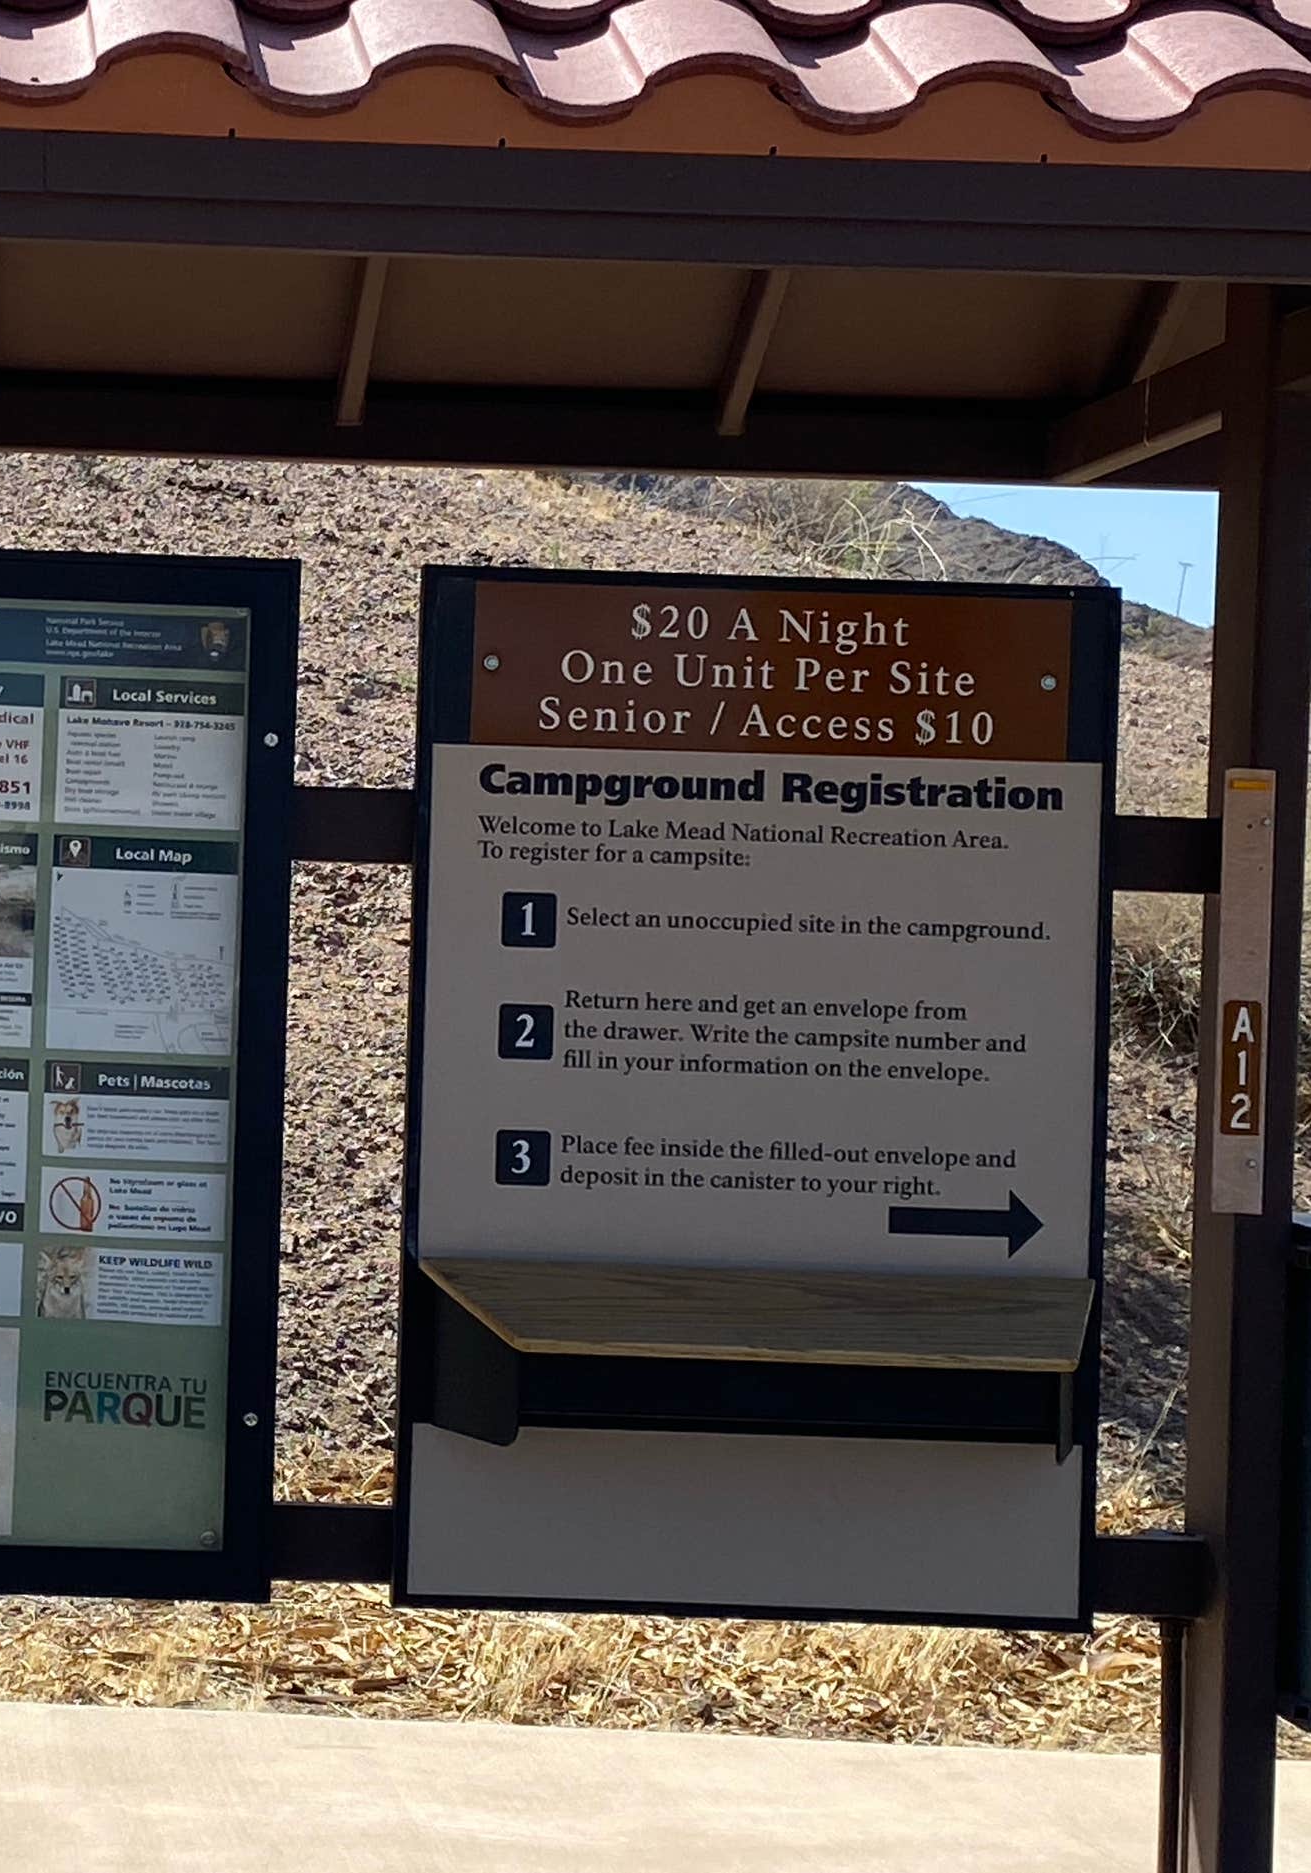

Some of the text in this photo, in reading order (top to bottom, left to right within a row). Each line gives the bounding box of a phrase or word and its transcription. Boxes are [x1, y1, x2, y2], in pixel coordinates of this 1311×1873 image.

[632, 604, 908, 654] $20 A Night
[562, 650, 974, 696] One Unit Per Site
[113, 689, 217, 705] Local Services
[540, 697, 993, 745] Senior / Access $10
[6, 740, 29, 749] VHF
[15, 754, 27, 764] 16
[480, 764, 1062, 813] Campground Registration
[478, 815, 1008, 849] Welcome to Lake Mead National Recreation Area.
[116, 848, 192, 865] Local Map
[478, 840, 749, 870] To register for a campsite:
[522, 903, 535, 935] 1
[567, 907, 1049, 943] Select an unoccupied site in the campground.
[565, 990, 966, 1024] Return here and get an envelope from
[516, 1014, 534, 1047] 2
[565, 1020, 1025, 1052] the drawer. Write the campsite number and
[98, 1074, 211, 1090] Pets Mascotas
[563, 1049, 988, 1086] fill in your information on the envelope.
[512, 1140, 530, 1173] 3
[561, 1135, 1015, 1171] Place fee inside the filled-out envelope and
[561, 1165, 940, 1200] deposit in the canister to your right.
[99, 1255, 212, 1269] KEEP WILDLIFE WILD
[45, 1371, 207, 1395] ENCUENTRA TU
[44, 1390, 206, 1429] PARQUE
